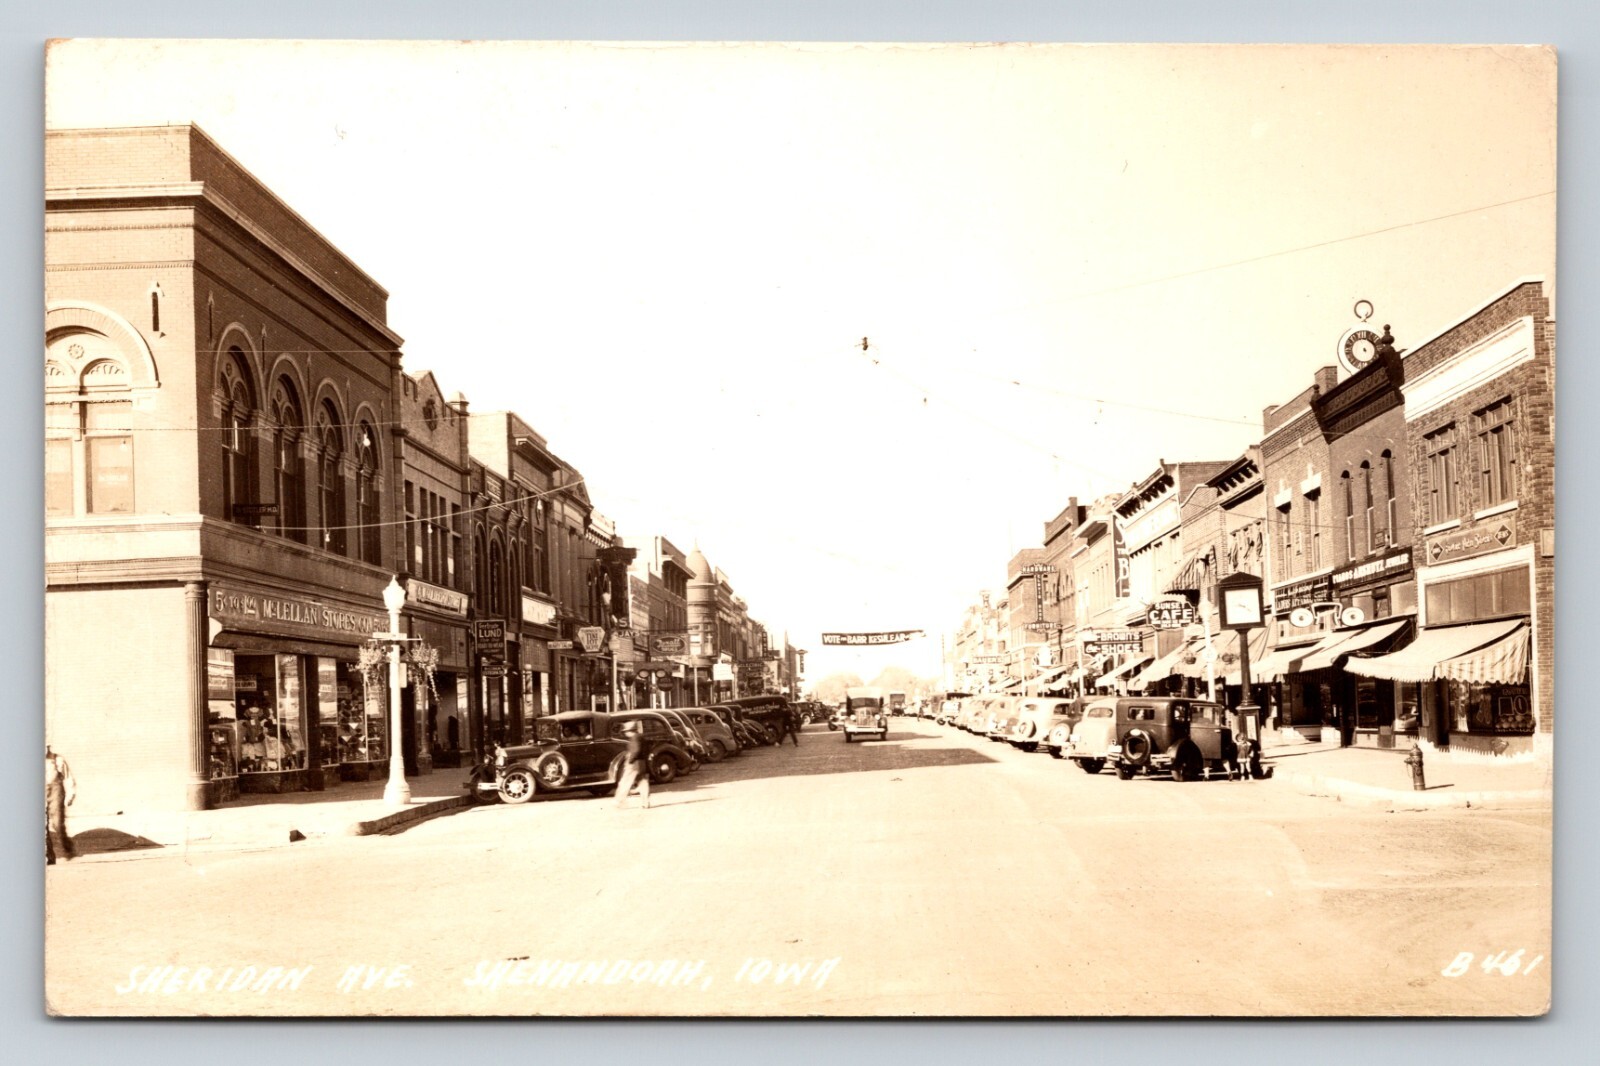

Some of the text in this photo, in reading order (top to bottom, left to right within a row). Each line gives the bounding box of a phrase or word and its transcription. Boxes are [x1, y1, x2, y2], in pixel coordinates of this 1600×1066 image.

[1155, 602, 1185, 610] SUNSET
[1149, 609, 1193, 621] CAFE
[322, 609, 356, 632] STORES
[479, 628, 501, 638] LUND
[1101, 643, 1140, 653] SHOES
